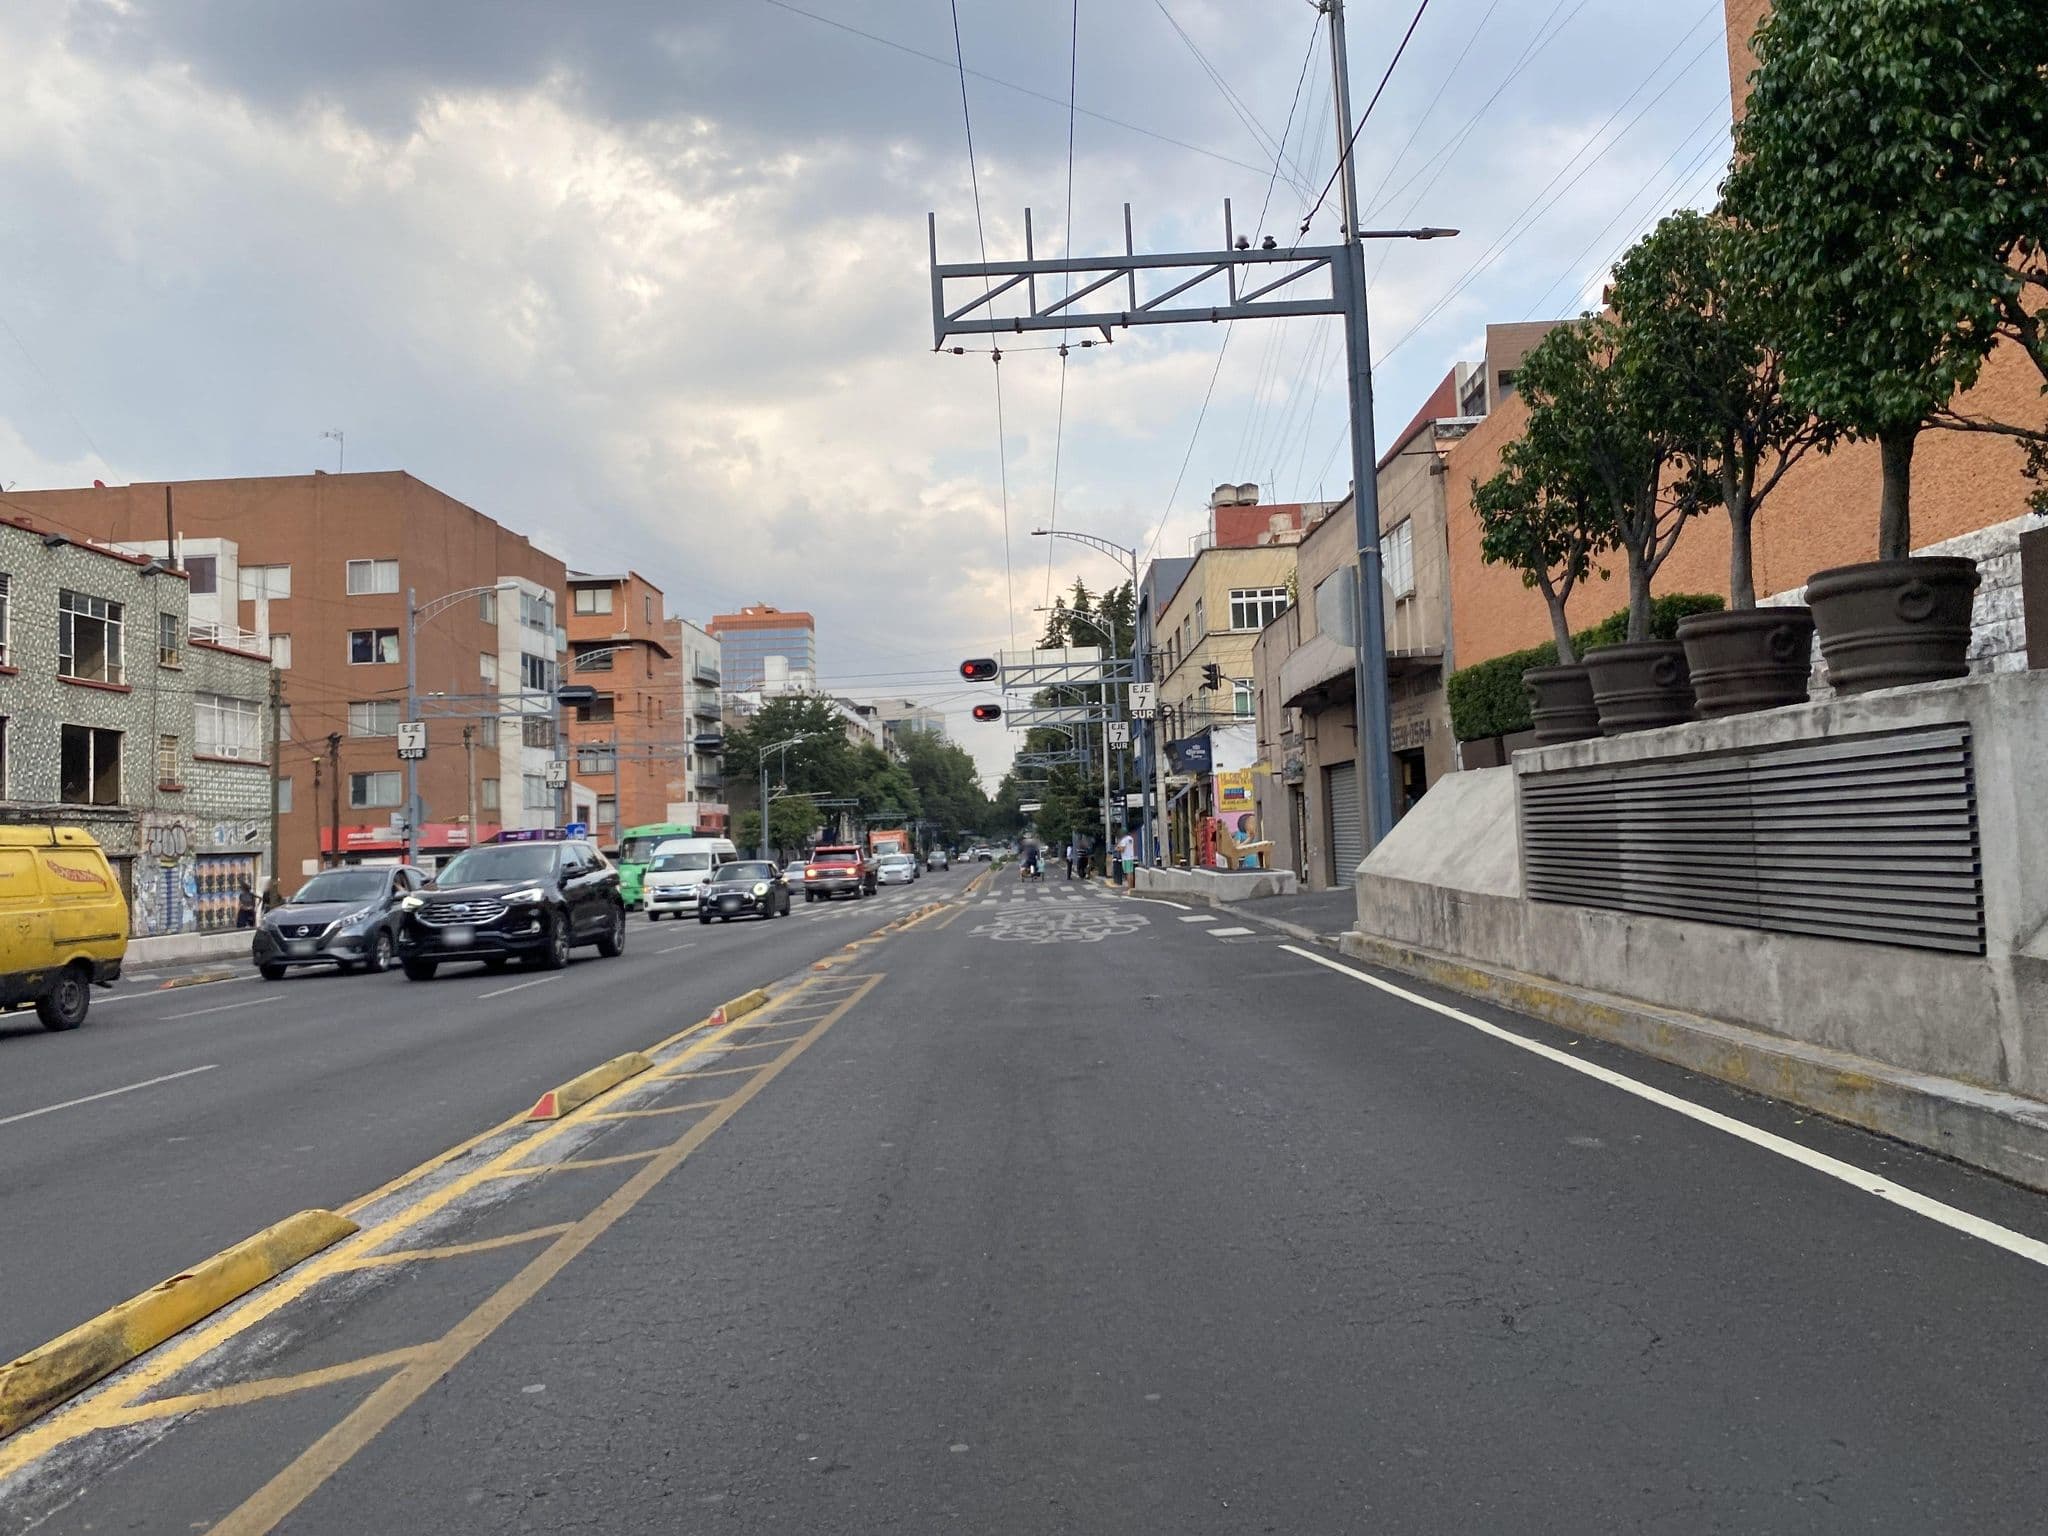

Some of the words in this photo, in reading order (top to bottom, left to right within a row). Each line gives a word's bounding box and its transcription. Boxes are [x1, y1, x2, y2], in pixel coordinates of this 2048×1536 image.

[1132, 685, 1151, 693] EJE
[1138, 696, 1146, 708] 7
[1131, 710, 1154, 719] SUR
[402, 724, 421, 733] EJE
[1111, 723, 1126, 731] EJE
[1116, 732, 1122, 741] 7
[407, 735, 415, 748] 7
[1110, 742, 1128, 750] SUR
[400, 749, 424, 759] SUR
[553, 770, 559, 780] 7
[547, 781, 565, 789] SUR
